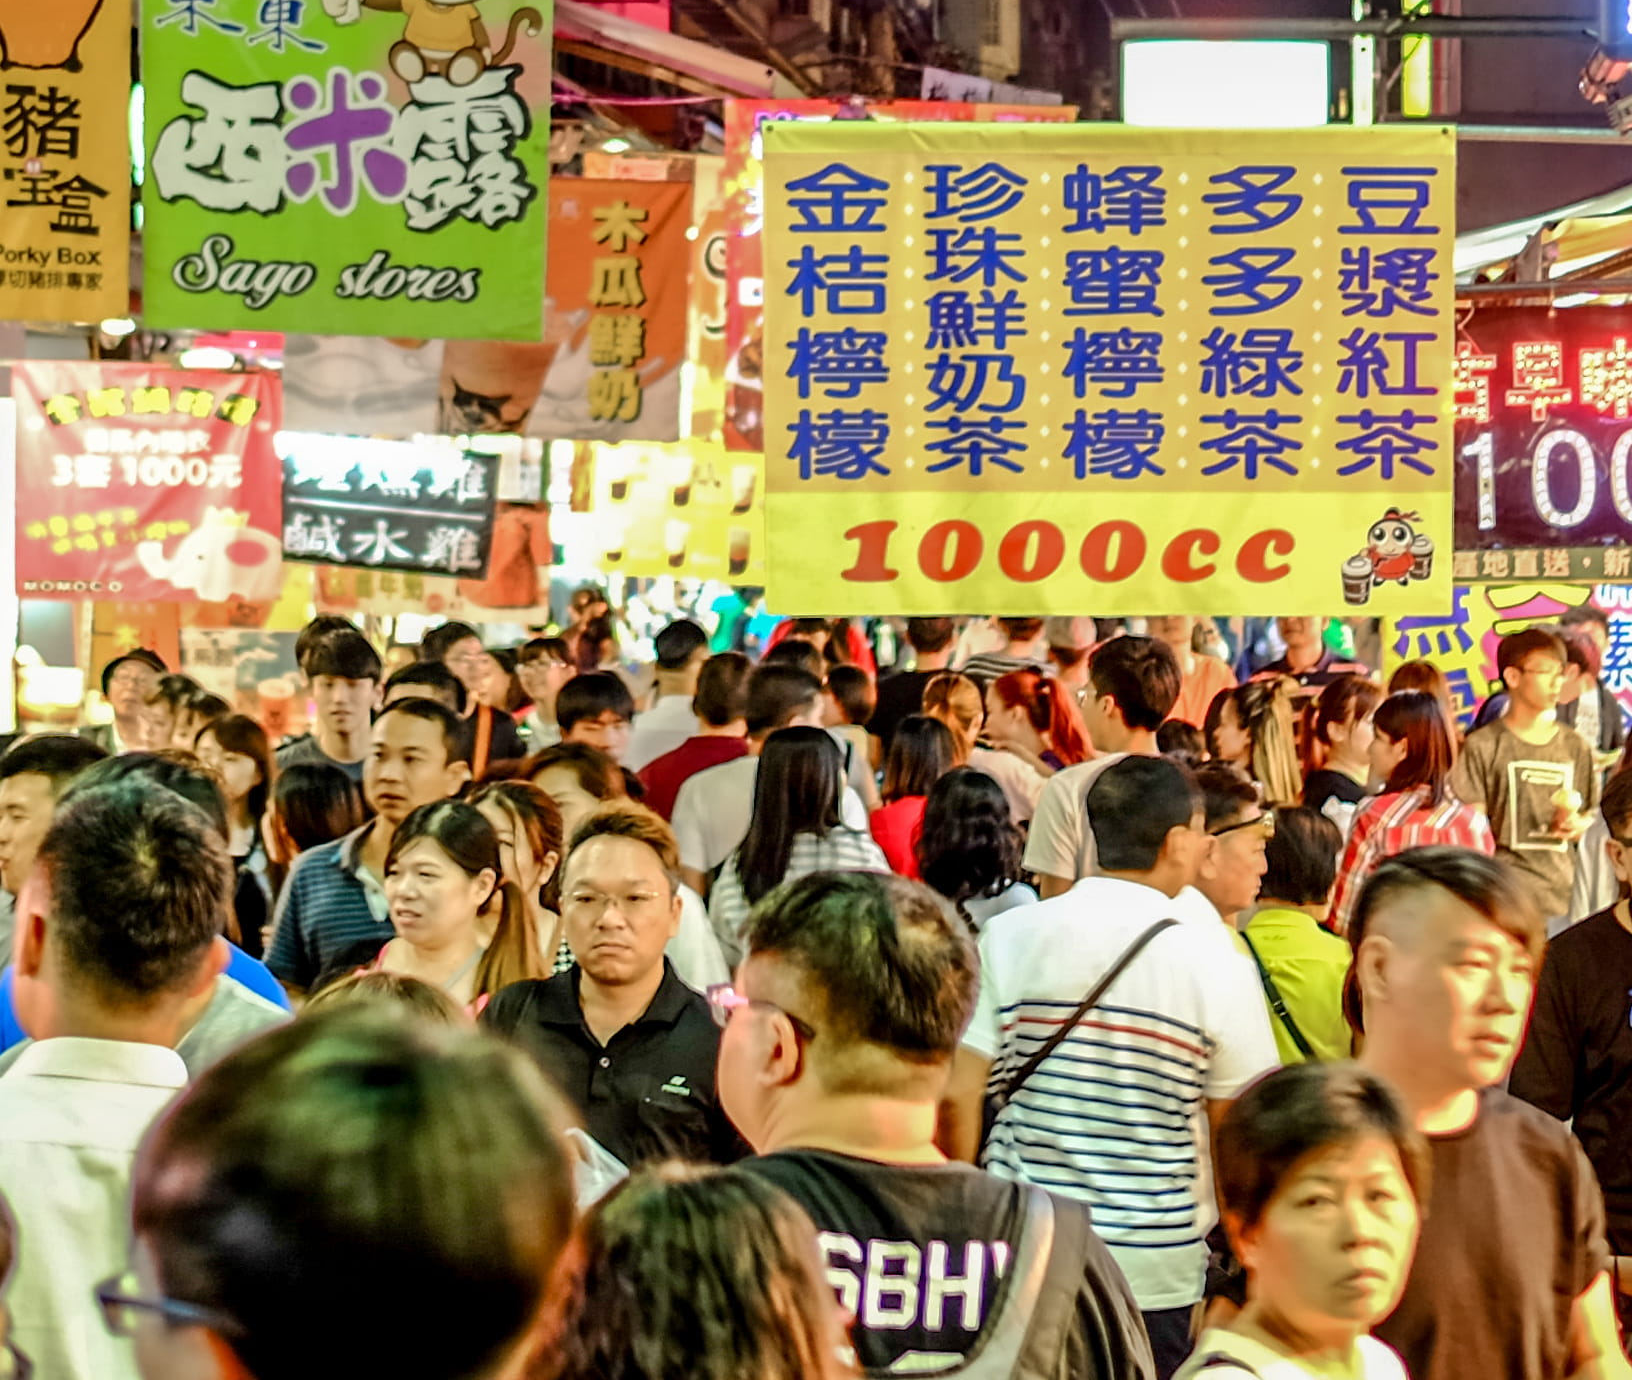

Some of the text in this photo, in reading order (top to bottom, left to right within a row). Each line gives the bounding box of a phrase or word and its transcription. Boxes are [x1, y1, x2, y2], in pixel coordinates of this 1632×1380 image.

[56, 246, 102, 266] Box
[154, 64, 539, 233] 西米露
[173, 234, 481, 310] Sago stores
[587, 200, 649, 424] 木瓜鮮奶
[784, 161, 892, 480] 金桔檸檬
[924, 162, 1029, 477] 珍珠鮮奶茶
[1063, 164, 1167, 480] 蜂蜜檸檬
[1199, 165, 1304, 479] 多多綠茶
[1337, 166, 1440, 480] 豆漿紅茶
[283, 509, 482, 571] 鹹水雞
[840, 519, 1297, 584] 1000cc
